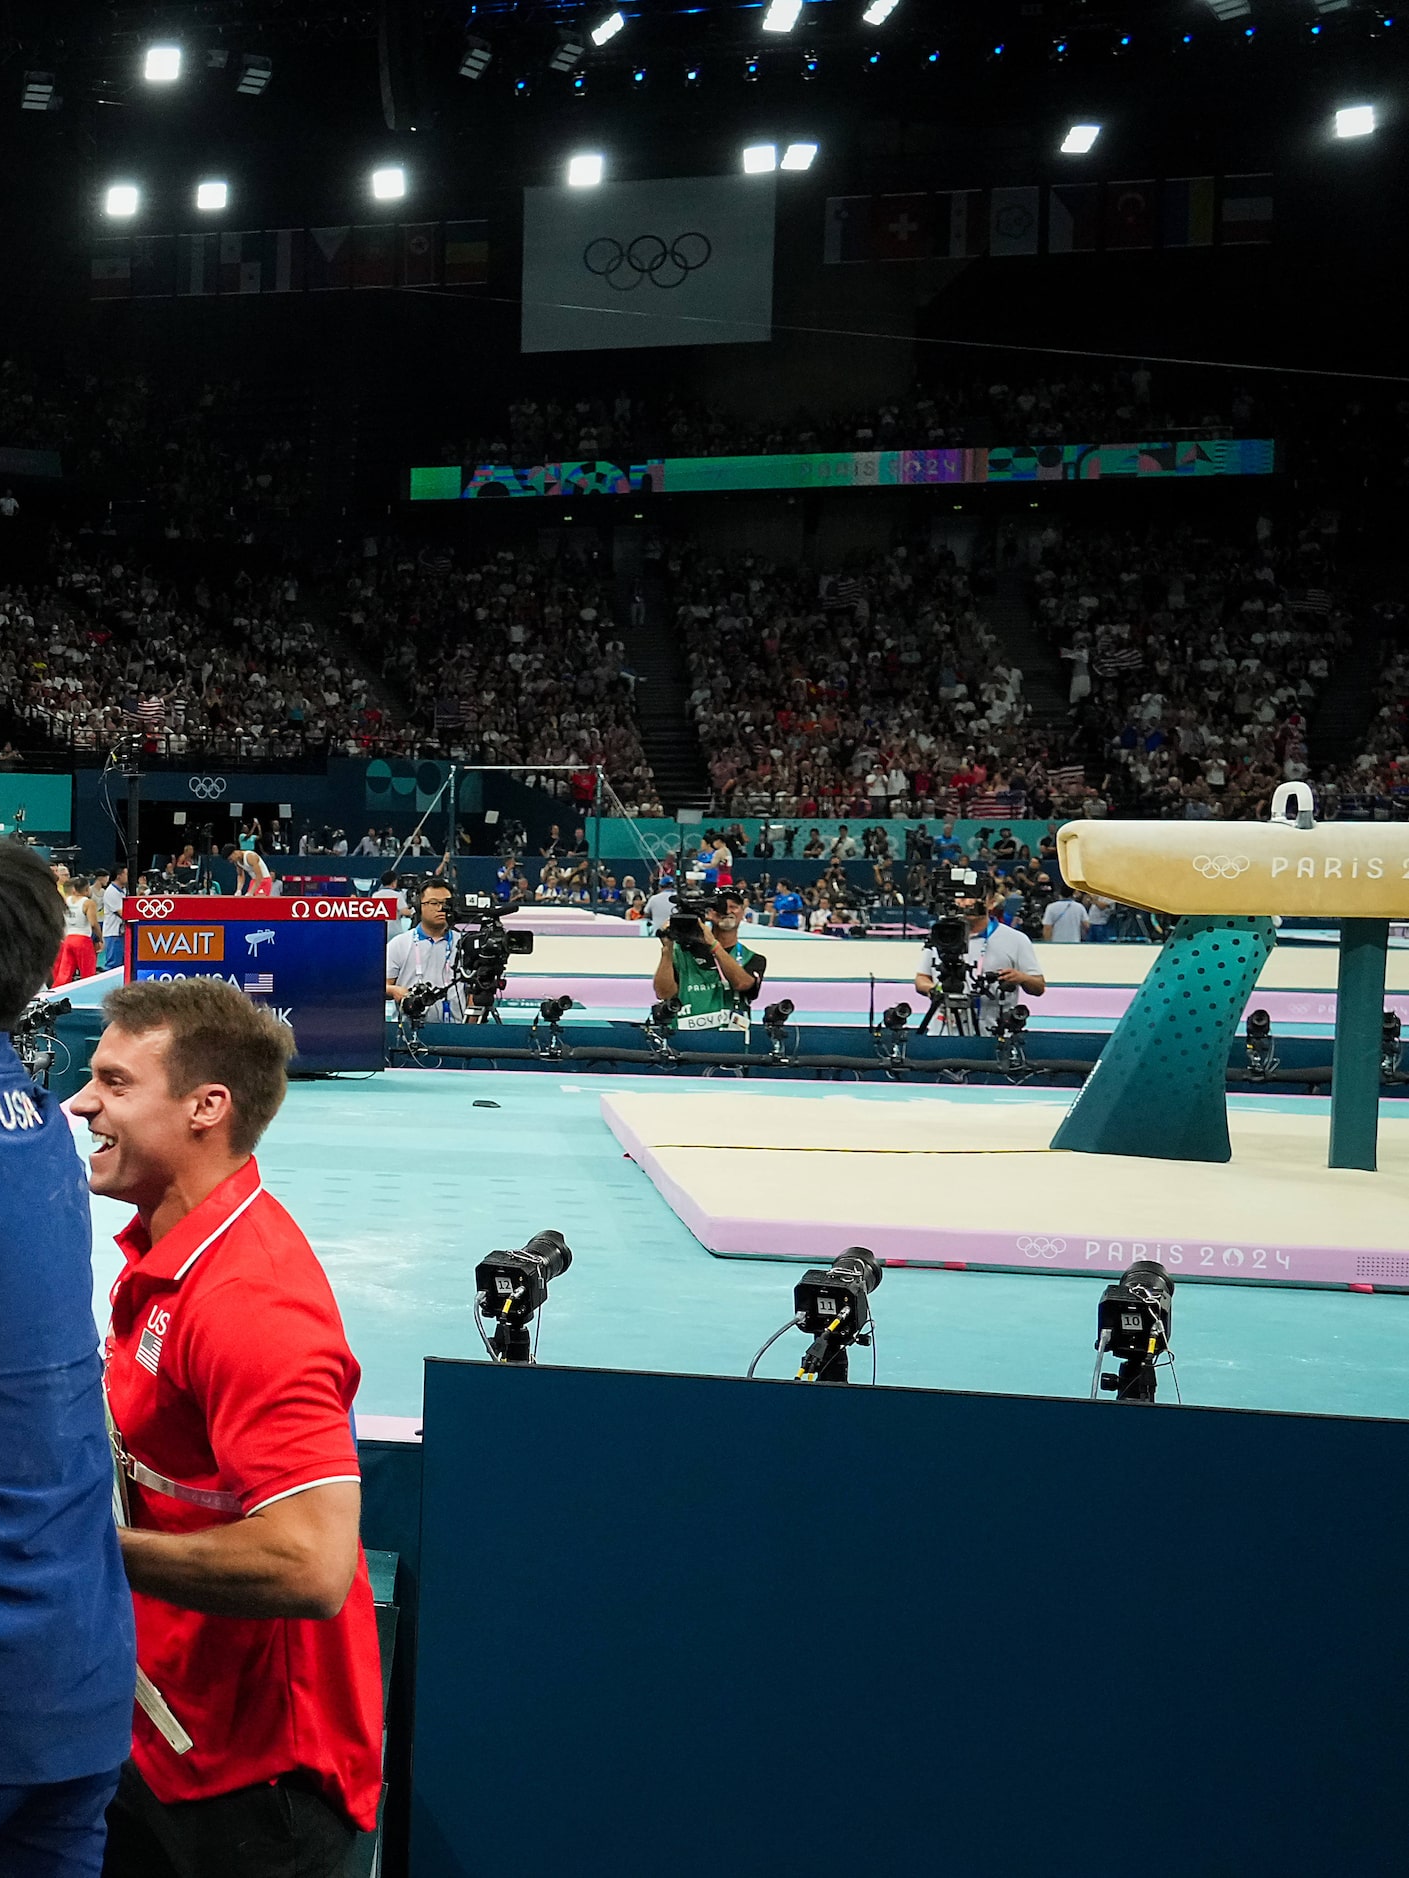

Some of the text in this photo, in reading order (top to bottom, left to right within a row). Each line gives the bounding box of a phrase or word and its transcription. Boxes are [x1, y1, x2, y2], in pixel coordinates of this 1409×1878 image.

[314, 900, 390, 918] OMEGA
[146, 931, 216, 955] WAIT
[1199, 1245, 1291, 1270] 2024
[497, 1280, 512, 1290] 12
[819, 1300, 834, 1311] 11
[147, 1304, 171, 1336] US
[1124, 1316, 1141, 1326] 10
